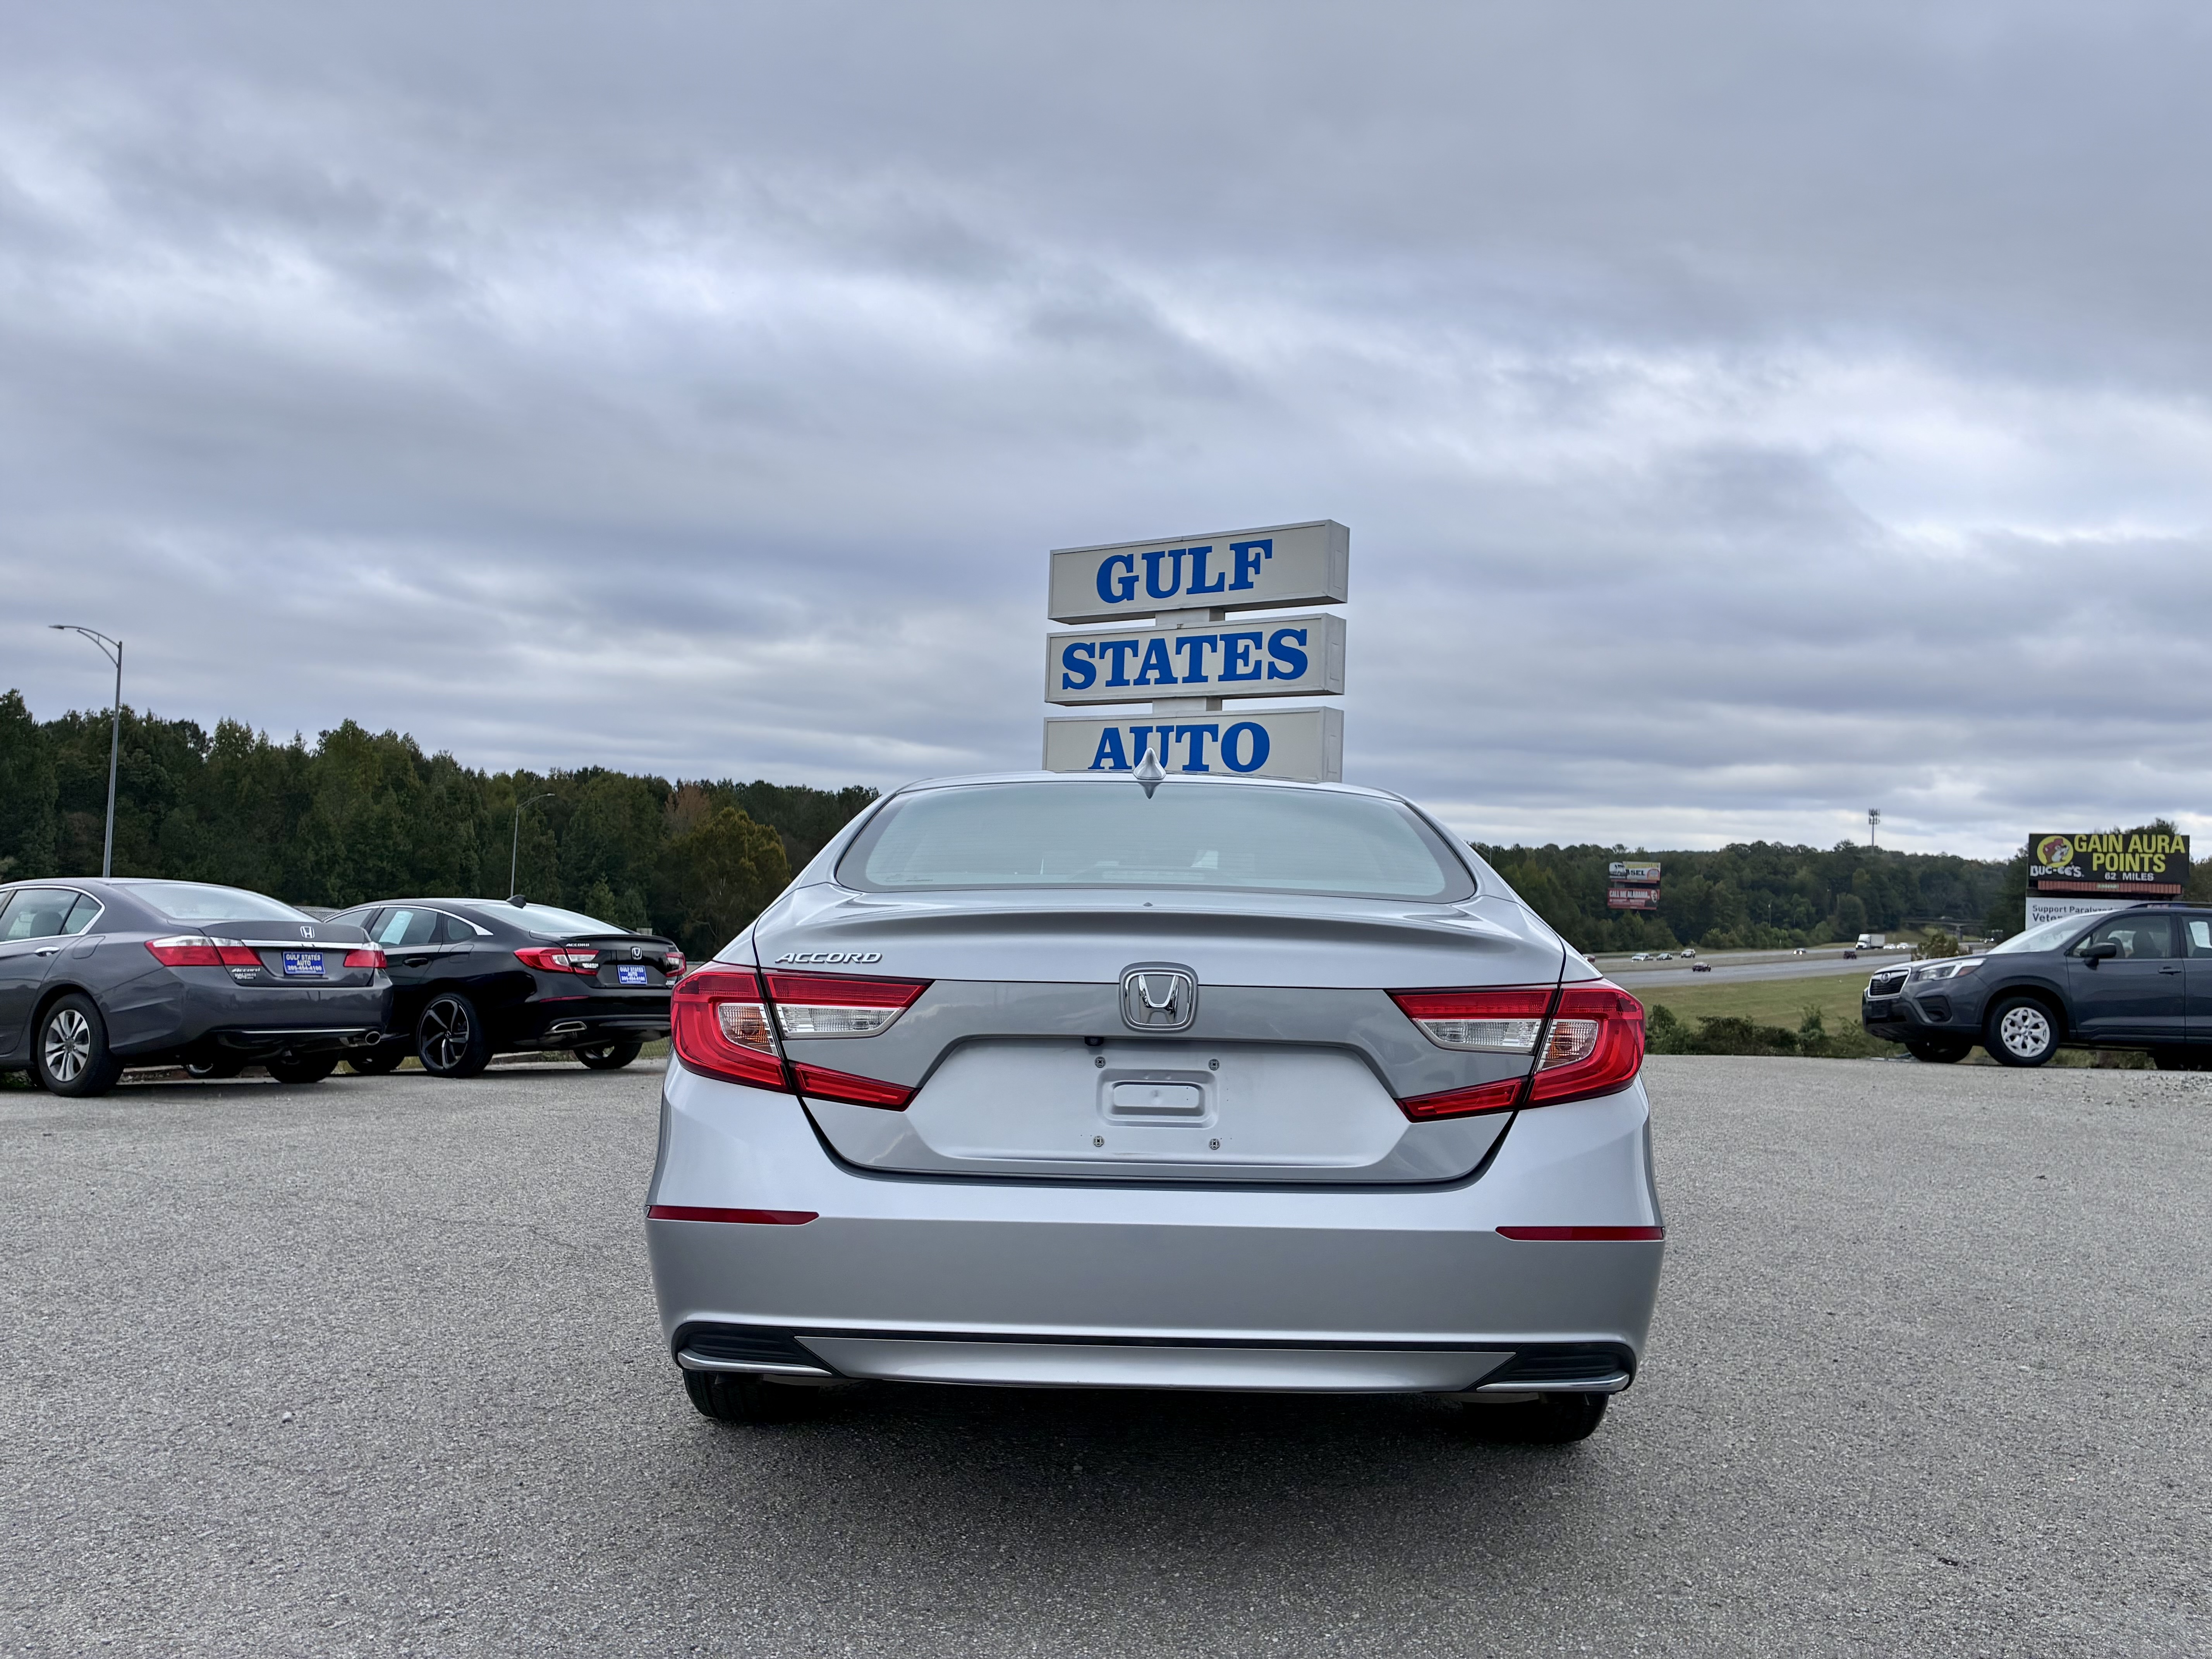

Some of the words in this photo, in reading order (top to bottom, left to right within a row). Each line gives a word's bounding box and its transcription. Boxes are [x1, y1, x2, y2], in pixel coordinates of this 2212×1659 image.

[1096, 539, 1273, 603] GULF
[1062, 629, 1308, 690] STATES
[1088, 722, 1270, 772] AUTO
[2074, 835, 2123, 852] GAIN
[2128, 835, 2185, 854] AURA
[2092, 853, 2166, 872] POINTS
[2105, 872, 2116, 880] 62
[2122, 872, 2154, 881] MILES
[2033, 905, 2066, 913] Support
[775, 953, 882, 963] ACCORD
